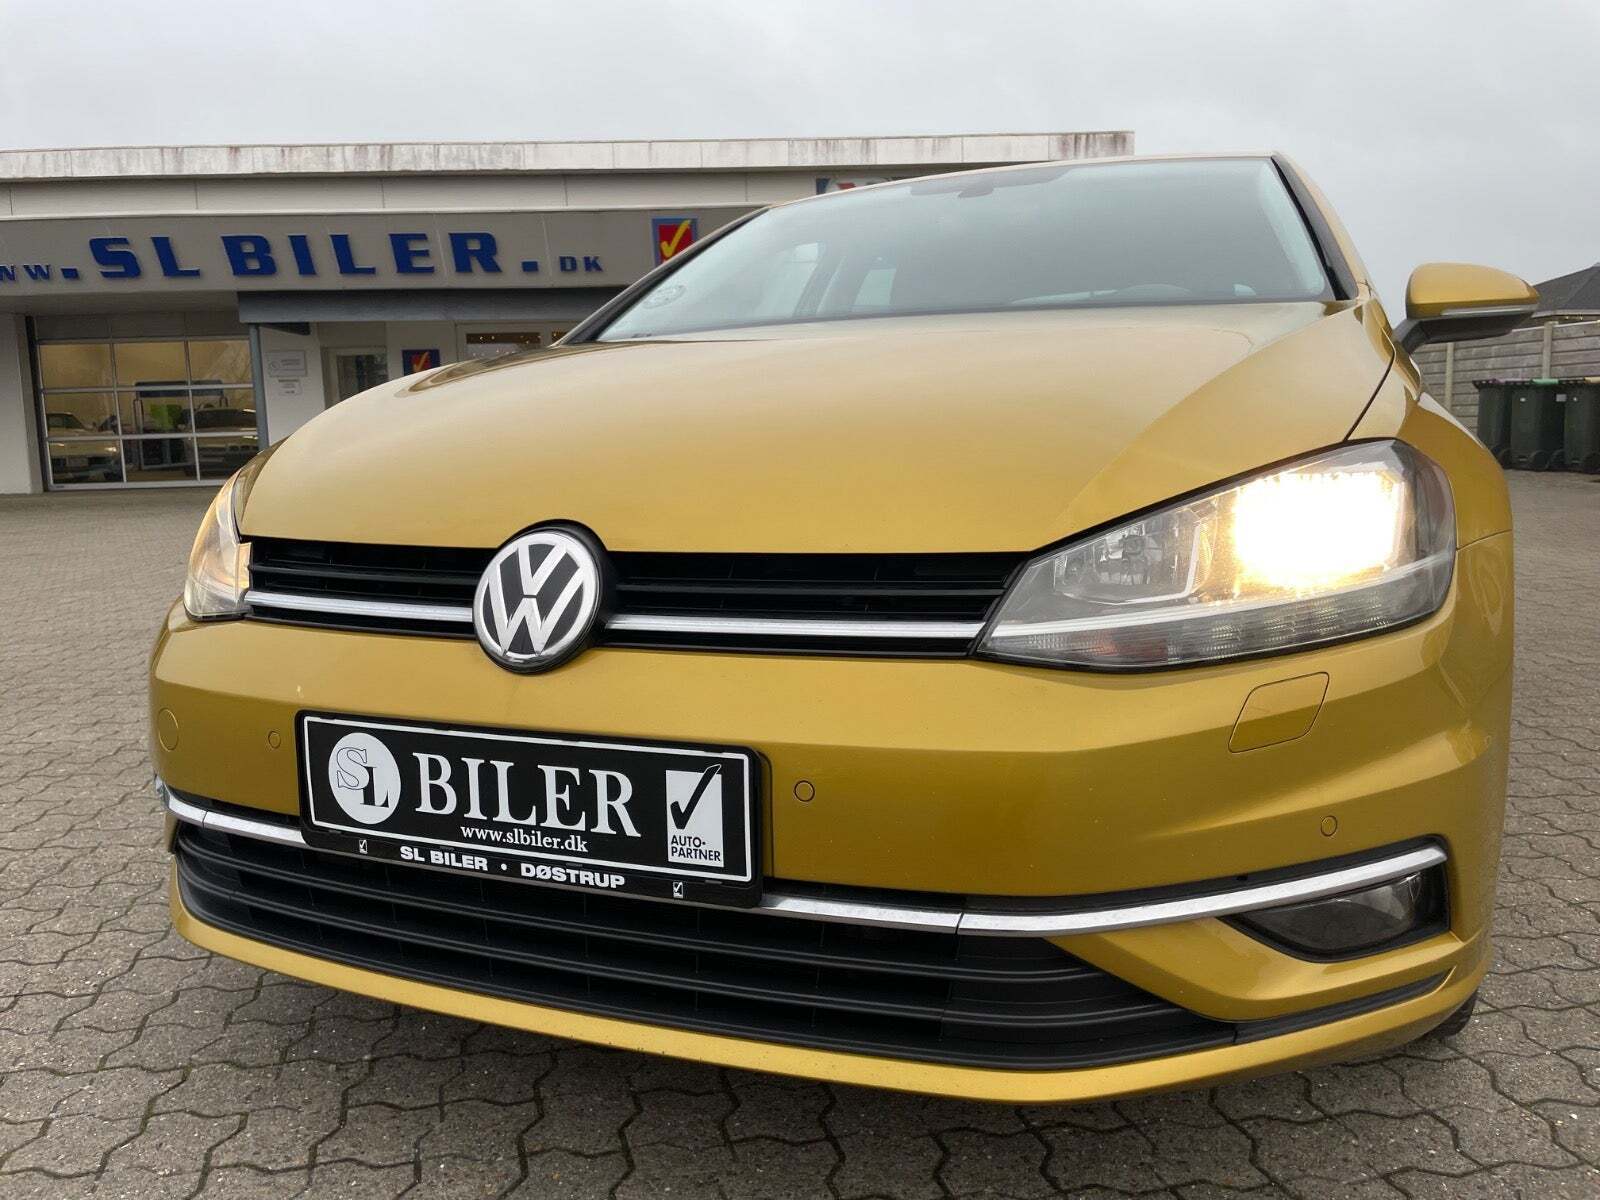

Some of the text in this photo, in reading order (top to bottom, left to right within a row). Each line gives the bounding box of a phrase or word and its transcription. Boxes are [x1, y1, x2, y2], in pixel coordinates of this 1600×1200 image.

[336, 746, 642, 838] SL BILER
[460, 825, 589, 853] www.slbiler.dk
[670, 846, 721, 862] PARTNER
[400, 845, 625, 889] SL BILER DØSTRUP
